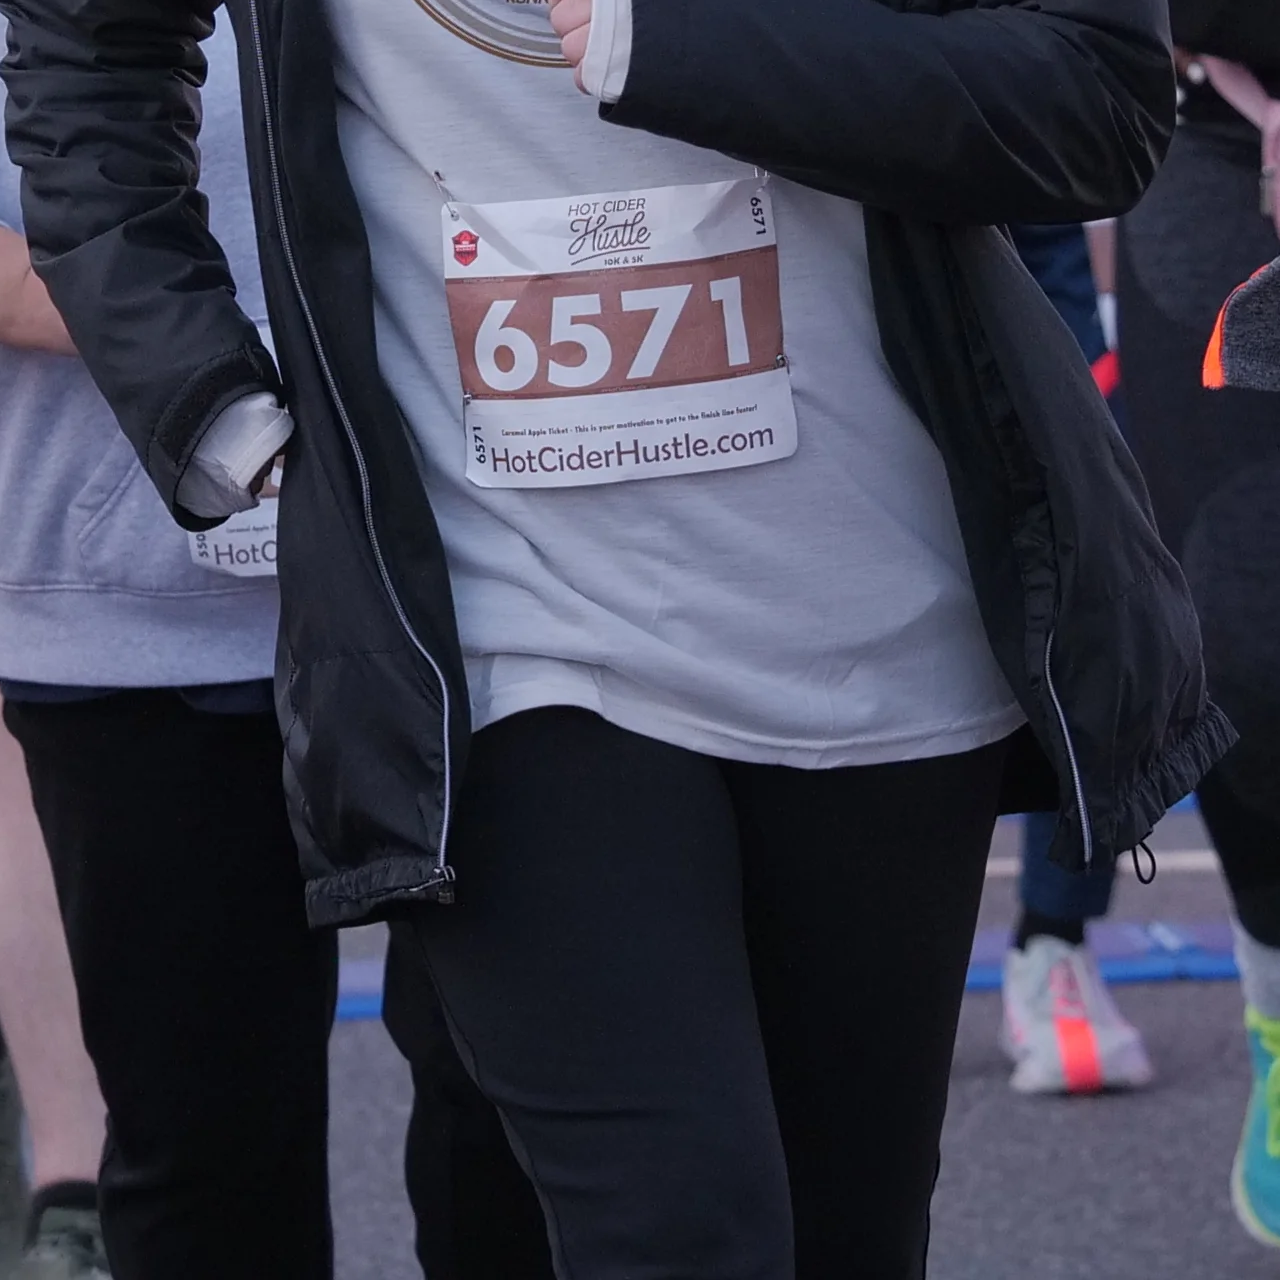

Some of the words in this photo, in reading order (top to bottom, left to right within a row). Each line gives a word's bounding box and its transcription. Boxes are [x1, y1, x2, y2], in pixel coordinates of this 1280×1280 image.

[567, 202, 600, 217] HOT
[602, 197, 646, 214] CIDER
[750, 196, 768, 236] 6571
[567, 211, 651, 255] Hustle
[604, 256, 620, 266] 10K
[622, 256, 629, 264] &
[631, 254, 644, 263] 5K
[474, 276, 751, 392] 6571
[501, 428, 527, 437] Caramel
[528, 428, 547, 438] Apple
[548, 426, 569, 435] Ticket
[575, 425, 589, 434] This
[599, 423, 615, 433] your
[616, 419, 655, 430] motivation
[665, 416, 677, 425] get
[687, 413, 699, 421] the
[701, 410, 721, 419] finish
[721, 408, 735, 416] line
[472, 426, 486, 464] 6571
[490, 426, 775, 473] HotCiderHustle.com
[195, 532, 209, 558] 550
[213, 539, 278, 565] HotC
